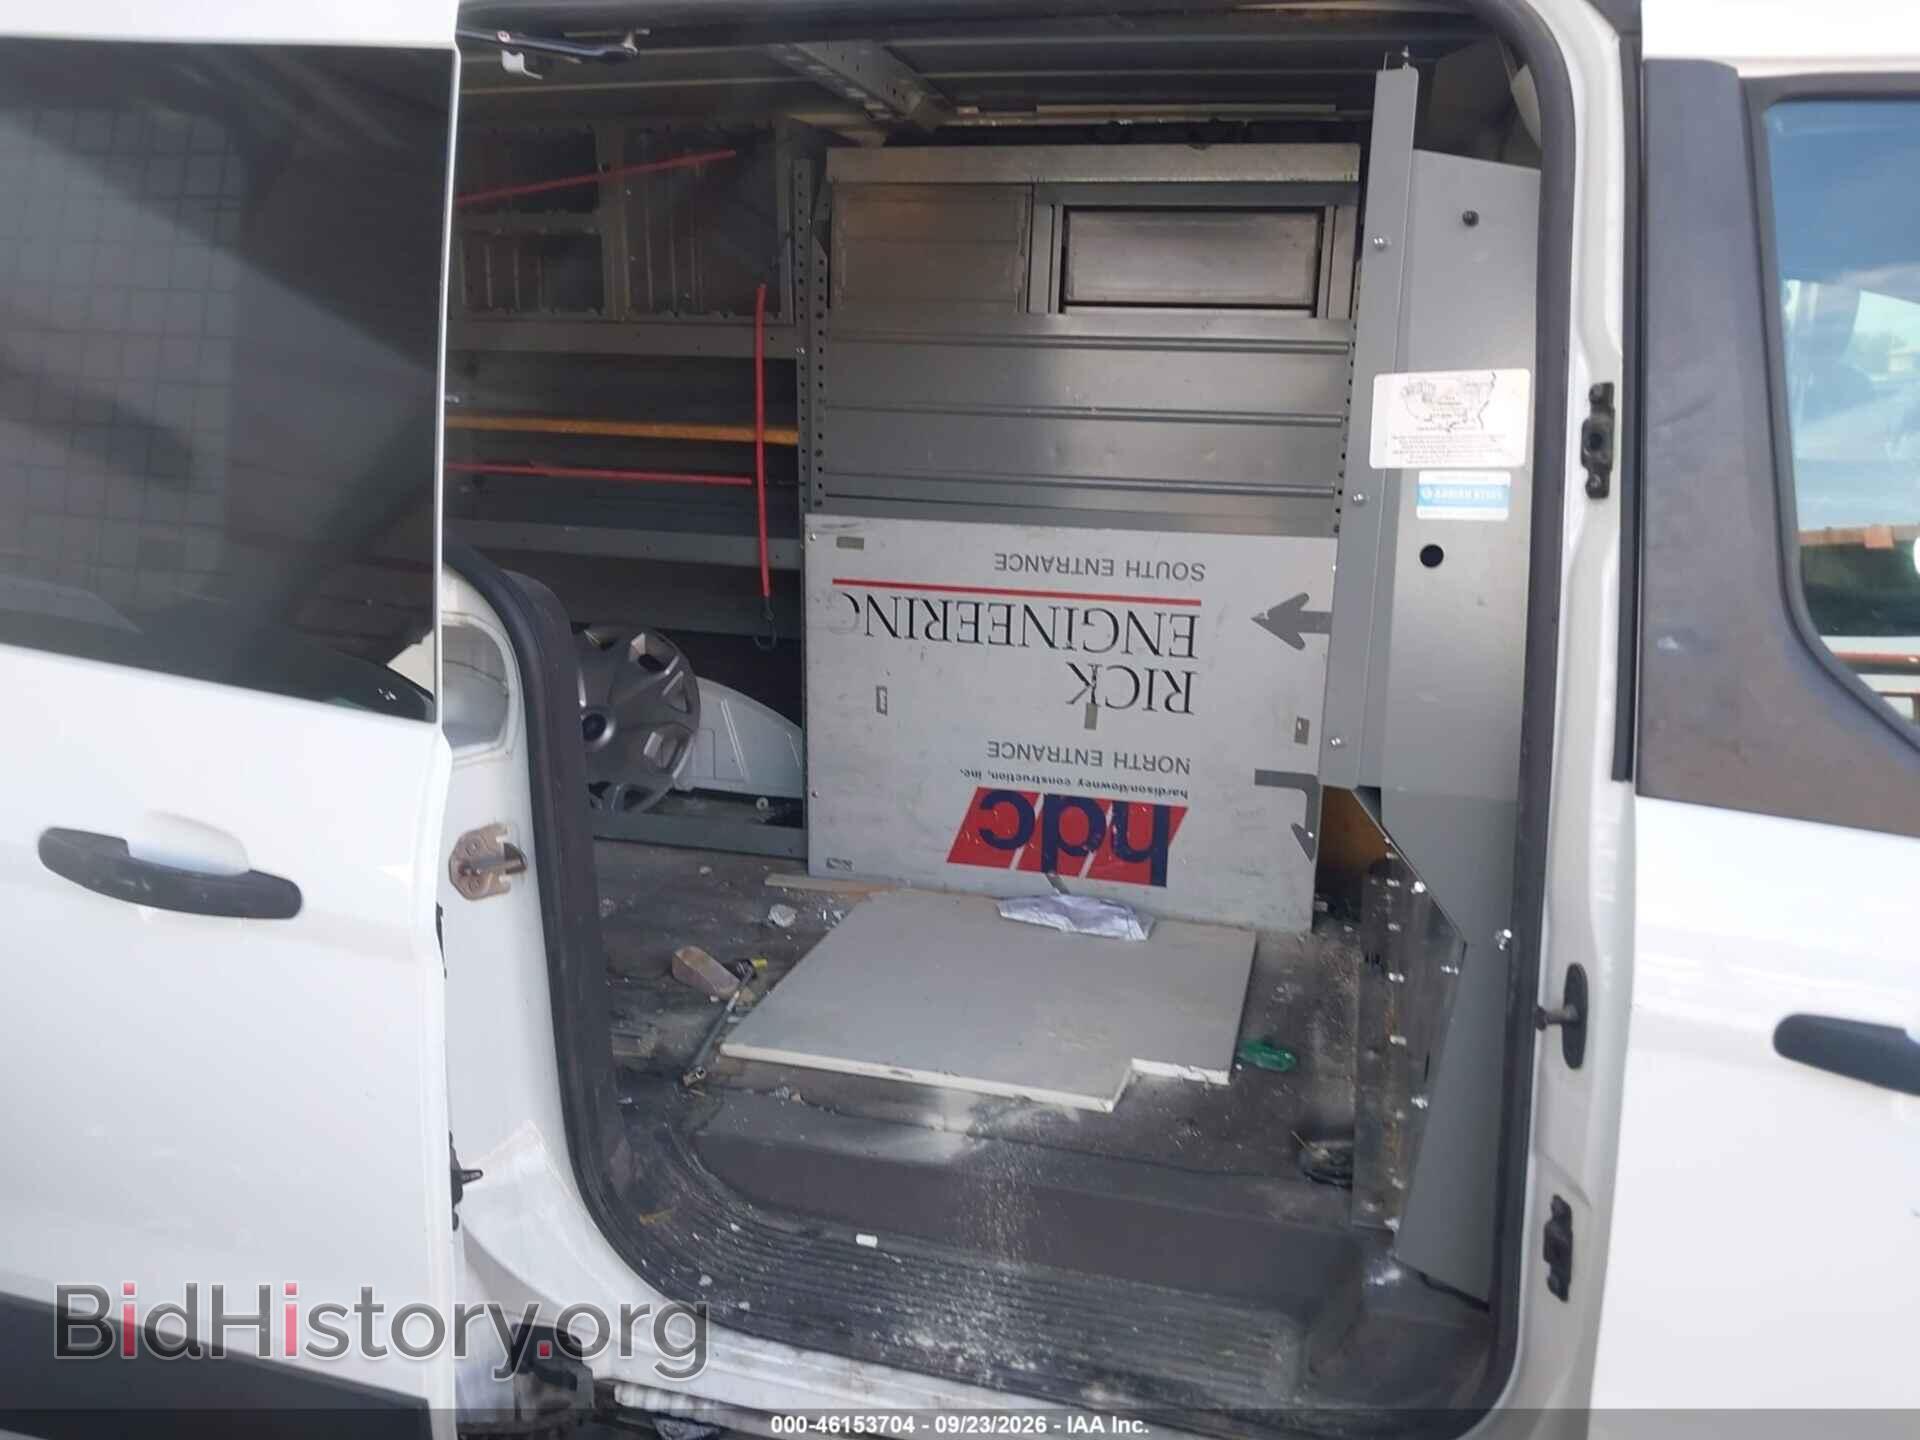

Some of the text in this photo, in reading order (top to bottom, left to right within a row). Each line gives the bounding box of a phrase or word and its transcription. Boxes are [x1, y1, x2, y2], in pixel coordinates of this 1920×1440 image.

[994, 552, 1206, 581] SOUTH ENTRANCE
[1065, 661, 1198, 715] RICK
[987, 741, 1191, 775] NORTH ENTRANCE
[960, 768, 983, 781] inc.
[987, 772, 1071, 789] construction,
[978, 789, 1171, 888] hdc
